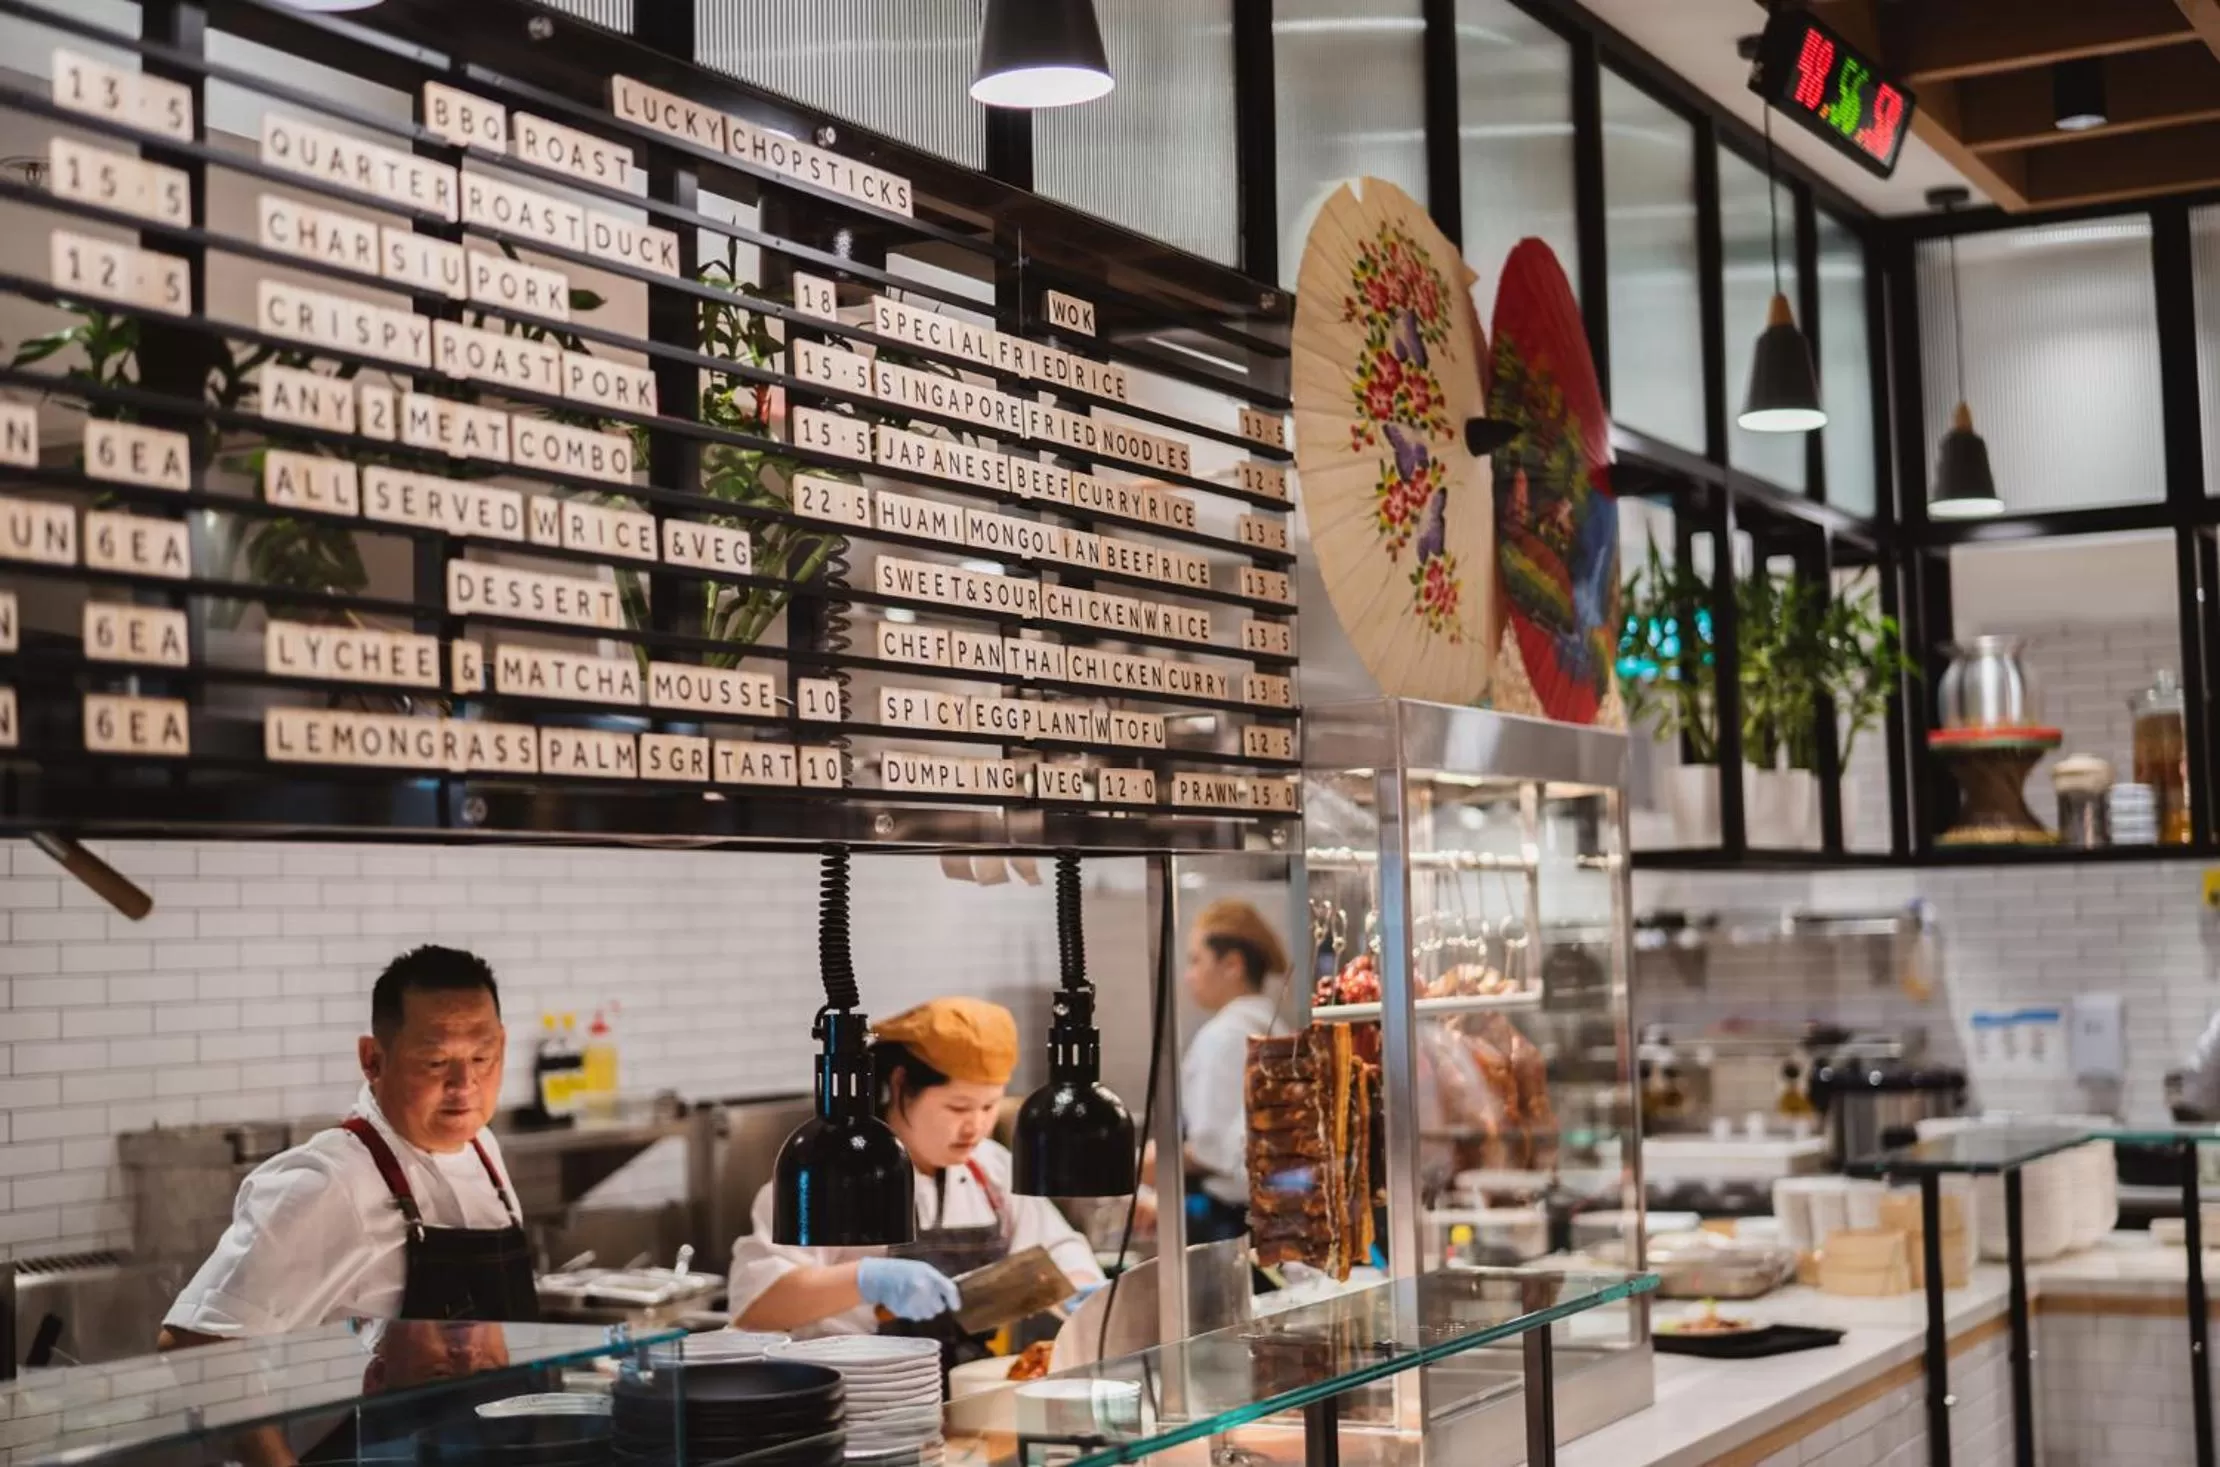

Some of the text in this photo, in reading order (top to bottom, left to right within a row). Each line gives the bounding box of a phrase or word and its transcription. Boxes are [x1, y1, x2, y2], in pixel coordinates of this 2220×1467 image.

[435, 99, 628, 184] BBQ ROAST
[623, 87, 908, 208] LUCKY CHOPSTICKS
[268, 212, 370, 261] CHAR
[392, 244, 459, 285] SIU
[479, 267, 564, 310] PORK
[270, 127, 831, 313] QUARTER ROAST DUCK 18
[268, 296, 424, 356] CRISPY
[444, 337, 553, 381] ROAST
[572, 366, 651, 407] PORK
[880, 307, 988, 359] SPECIAL
[1000, 341, 1068, 380] FRIED
[1077, 367, 1125, 399] RICE
[1053, 300, 1092, 330] WOK
[273, 382, 348, 421] ANY
[372, 400, 386, 429] 2
[410, 409, 503, 447] MEAT
[520, 432, 628, 474] COMBO
[882, 372, 1020, 428] SINGAPORE
[1031, 410, 1096, 445] FRIED
[1104, 432, 1188, 470] NOODLES
[276, 465, 747, 565] ALL SERVED W RICE &VEG
[885, 437, 1006, 484] JAPANESE
[1018, 467, 1068, 498] BEEF
[1078, 482, 1141, 517] CURRY
[1150, 497, 1194, 528] RICE
[883, 502, 959, 537] HUAMI
[970, 520, 1099, 564] MONGOLIAN
[1108, 543, 1153, 573] BEEF
[1163, 558, 1208, 585] RICE
[457, 573, 612, 618] DESSERT
[1048, 592, 1139, 629] CHICKEN
[1144, 611, 1157, 630] W
[1164, 613, 1208, 639] RICE
[278, 634, 836, 714] LYCHEE & MATCHA MOUSSE 10
[884, 631, 944, 660] CHEF
[959, 640, 1000, 667] PAN
[1010, 646, 1061, 673] THAI
[1072, 655, 1161, 687] CHICKEN
[1169, 668, 1228, 695] CURRY
[278, 721, 837, 781] LEMONGRASS PALM SGR TART 10
[887, 697, 963, 726] SPICY
[976, 704, 1088, 737] EGGPLANT
[1094, 716, 1109, 738] W
[1116, 719, 1162, 743] TOFU
[887, 760, 1014, 789] DUMPLING
[1043, 772, 1082, 794] VEG
[1181, 781, 1237, 801] PRAWN
